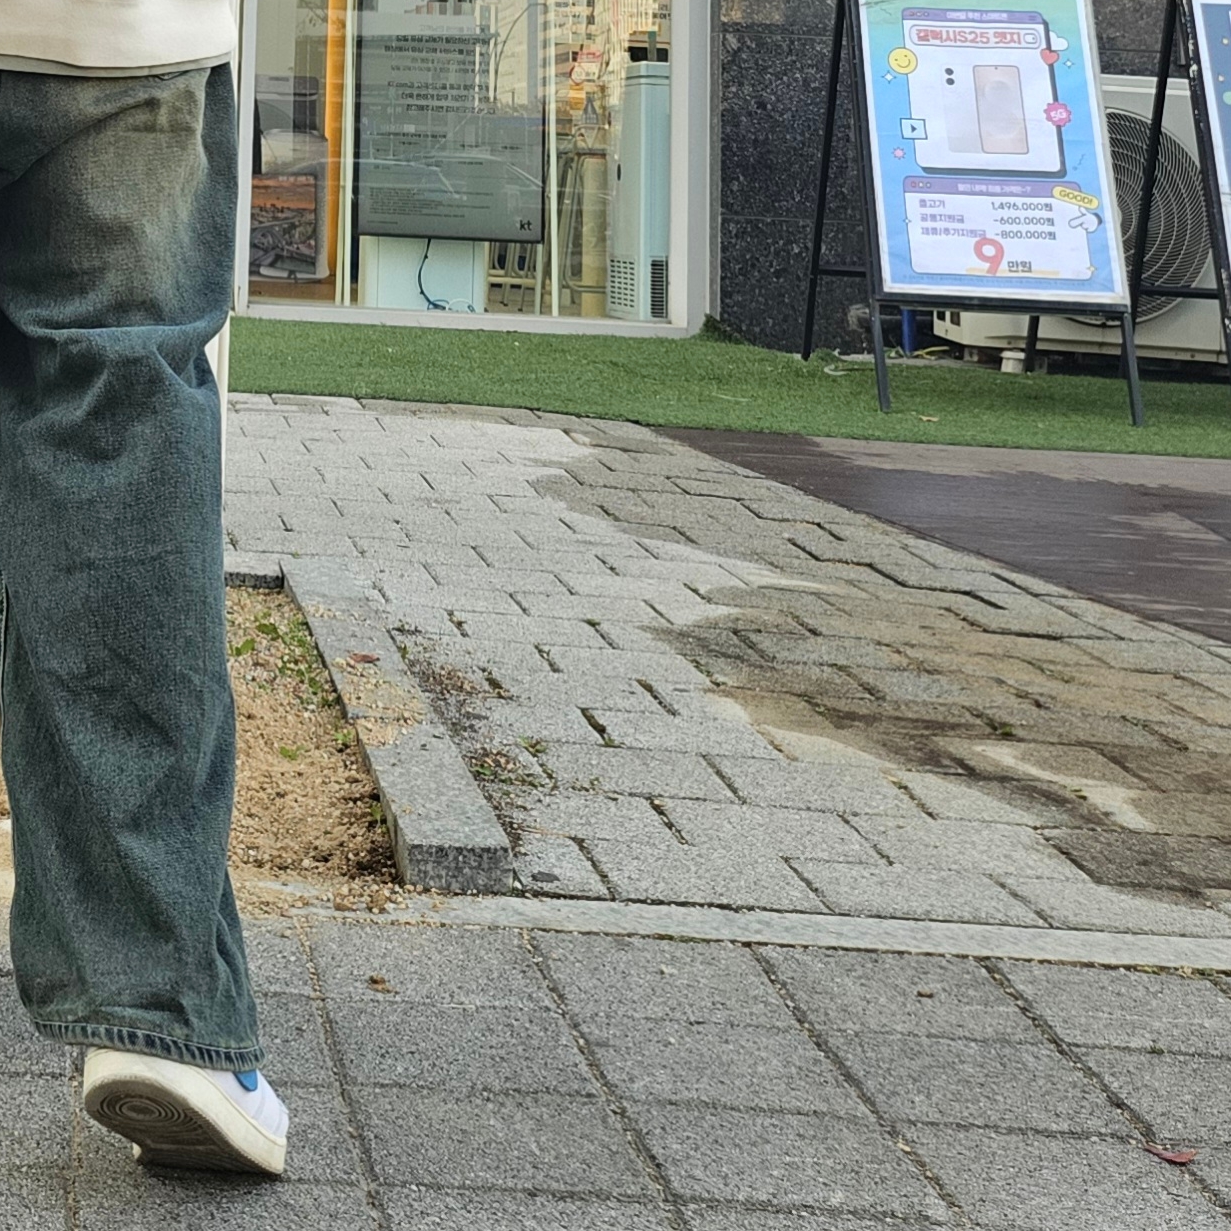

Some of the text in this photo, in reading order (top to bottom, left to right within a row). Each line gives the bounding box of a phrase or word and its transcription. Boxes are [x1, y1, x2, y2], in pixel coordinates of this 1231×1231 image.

[1058, 189, 1094, 206] GOOD!
[519, 220, 533, 232] kt
[973, 237, 1033, 276] 9 만원
